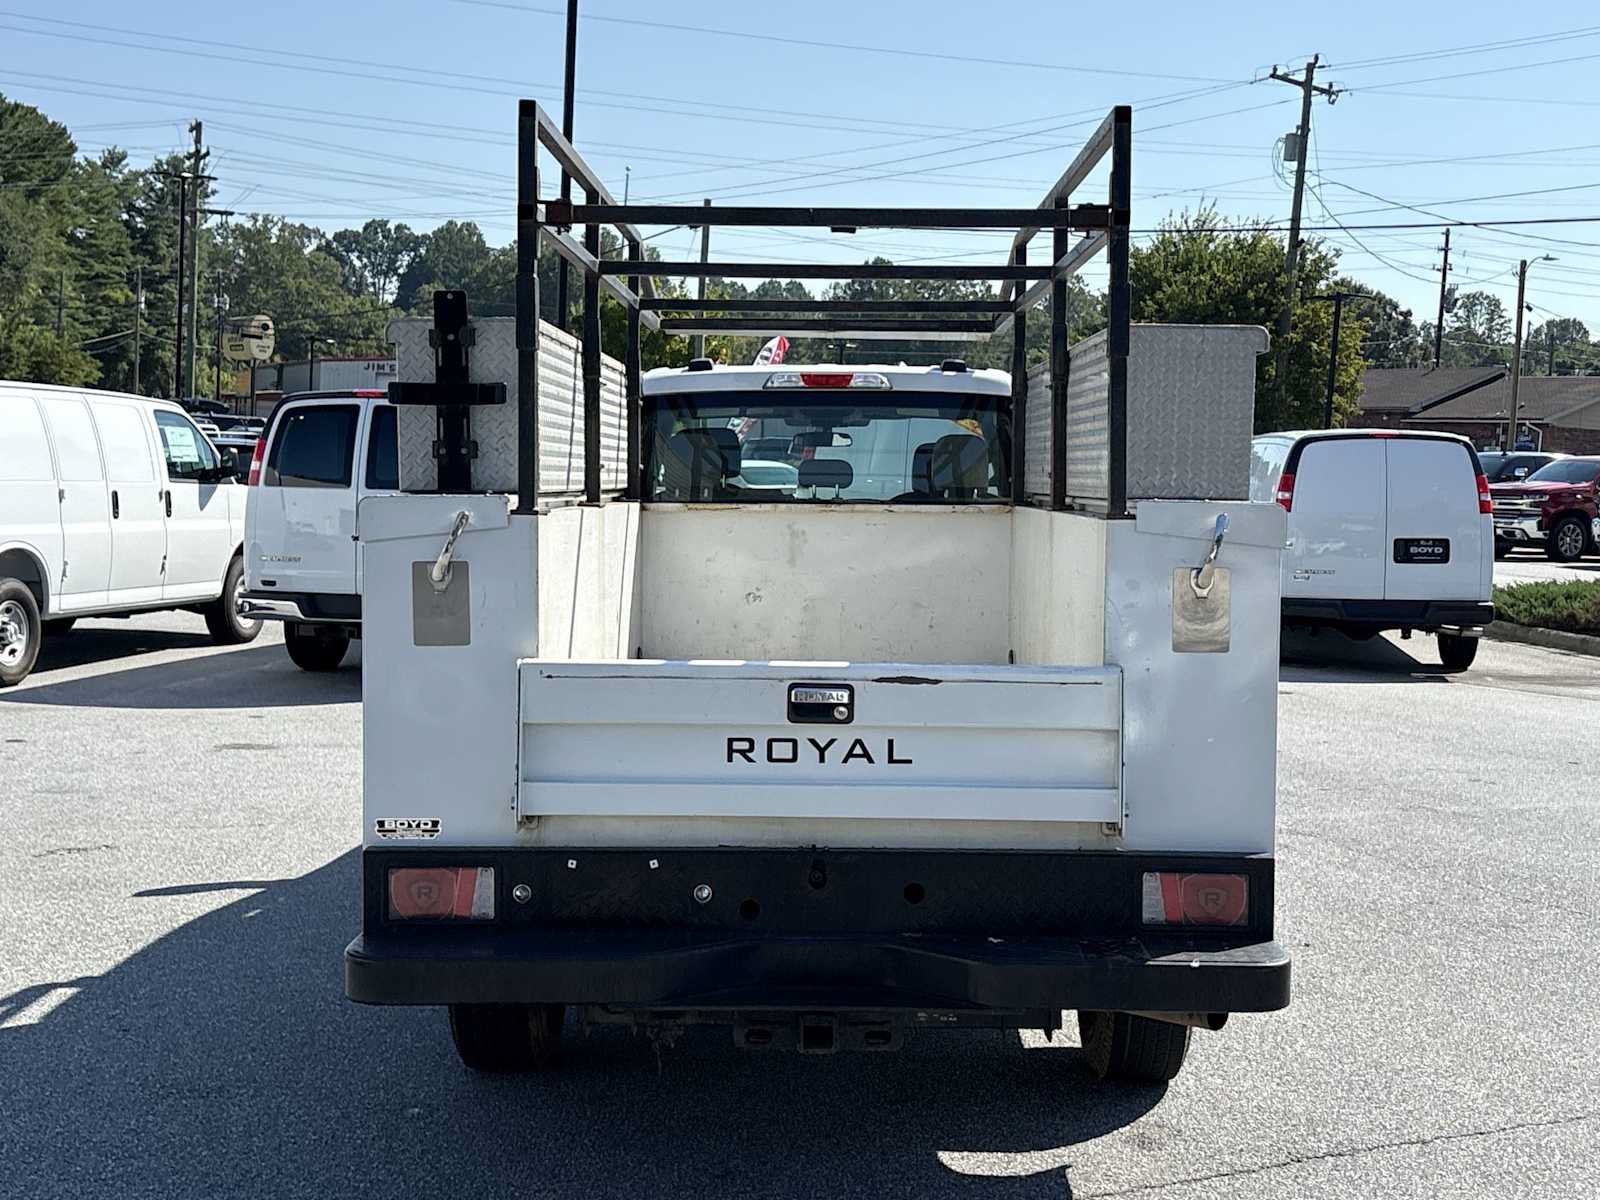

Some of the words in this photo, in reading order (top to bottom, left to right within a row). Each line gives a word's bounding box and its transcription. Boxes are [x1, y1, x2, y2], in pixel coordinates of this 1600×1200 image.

[794, 691, 844, 701] ROYAL
[727, 737, 912, 764] ROYAL
[385, 820, 432, 828] BOYD
[417, 886, 432, 898] R
[1205, 893, 1220, 905] R
